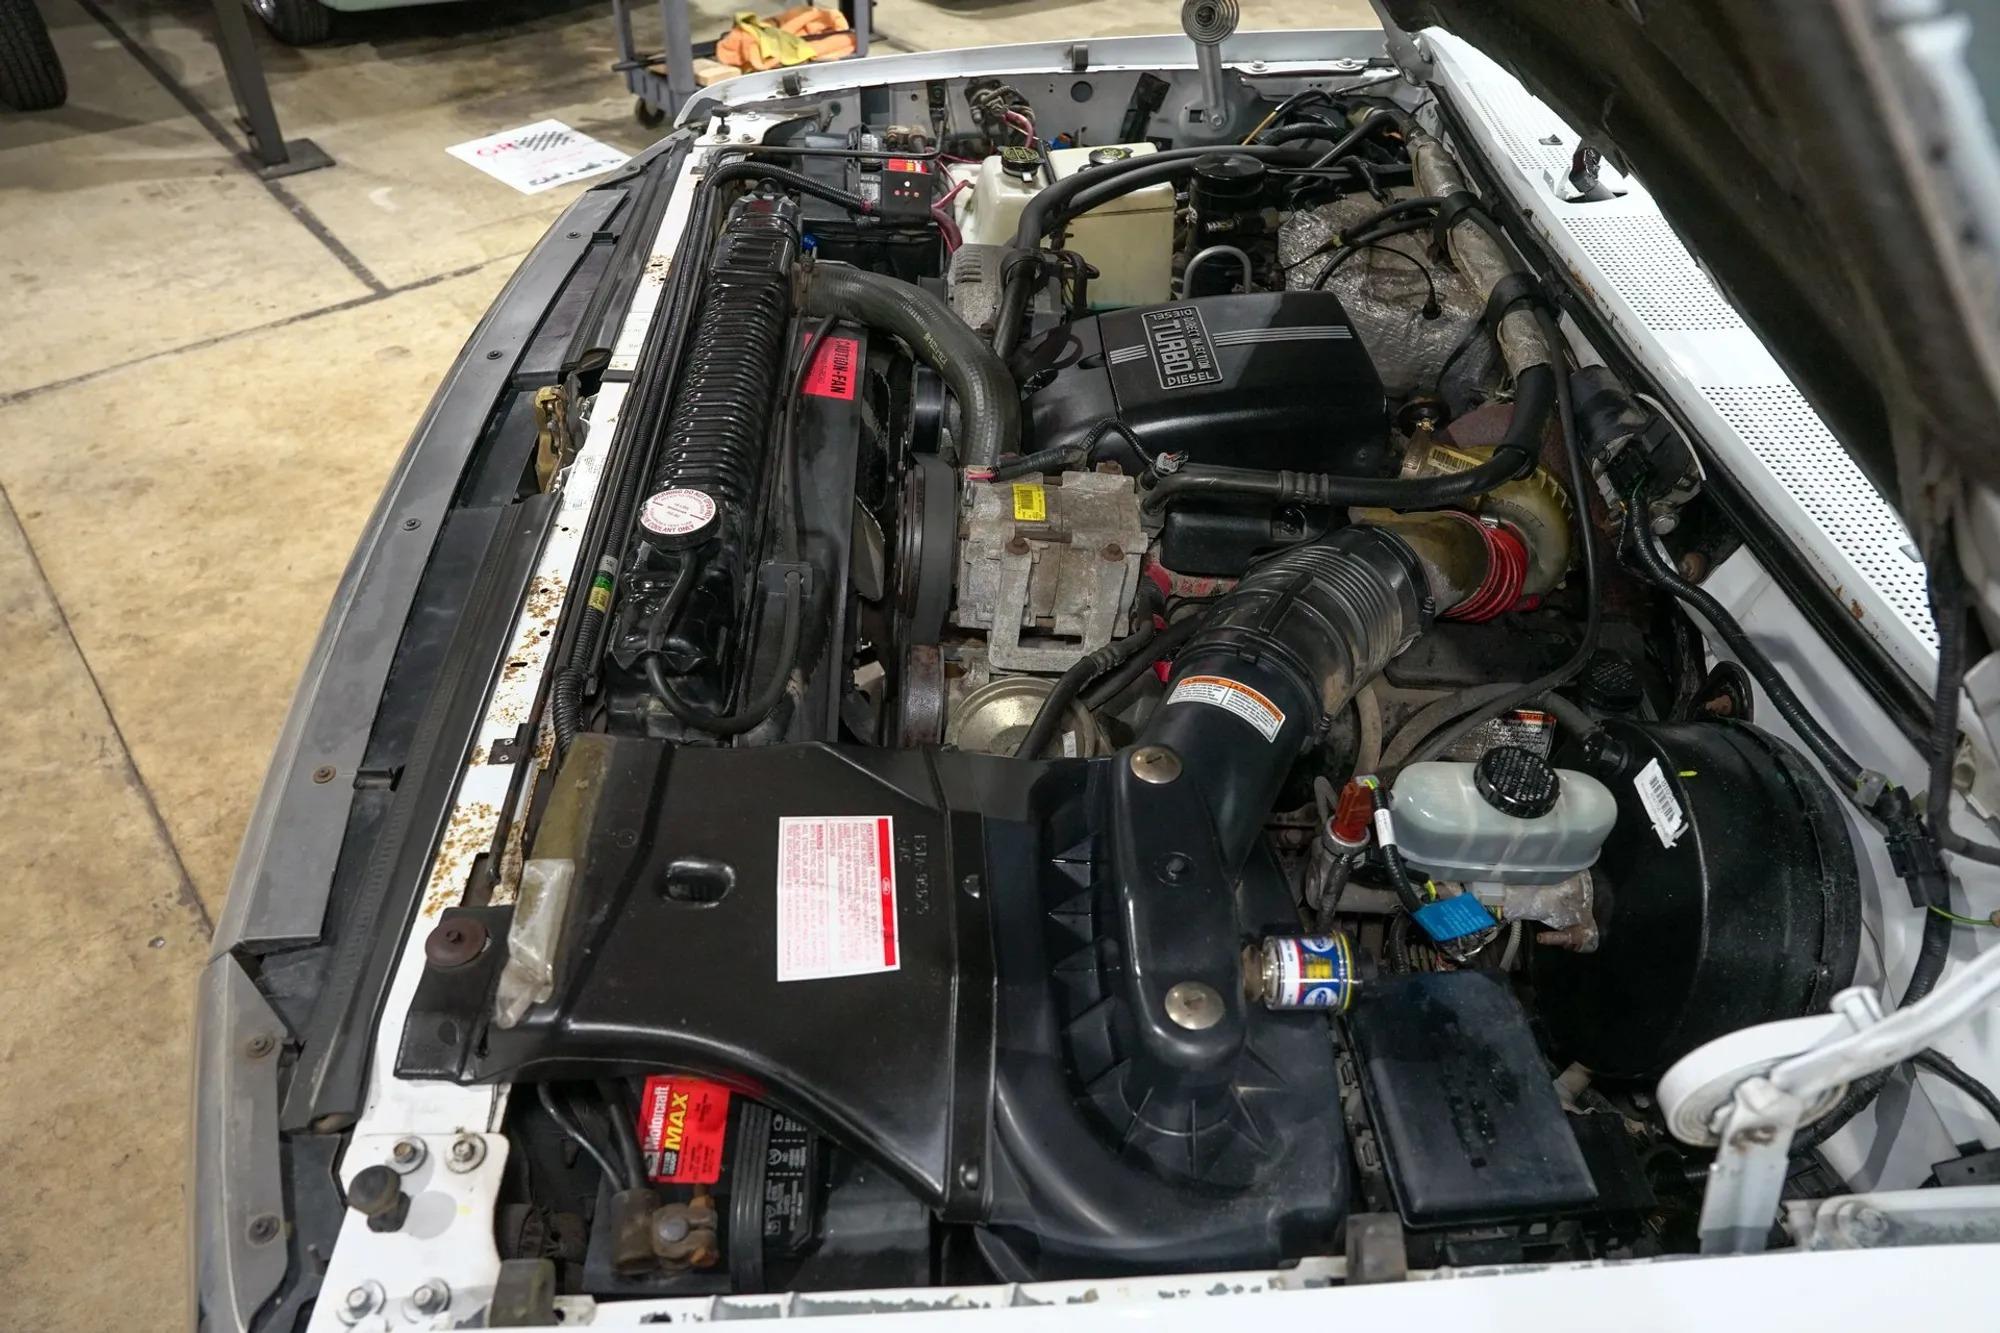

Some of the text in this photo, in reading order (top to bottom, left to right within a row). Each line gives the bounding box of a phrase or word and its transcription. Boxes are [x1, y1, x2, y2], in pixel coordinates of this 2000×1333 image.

[1150, 309, 1192, 320] DIESEL
[831, 340, 850, 394] CAUTION-FAN
[1152, 320, 1193, 374] TURBO
[1183, 317, 1211, 369] DIRECT INJECTION
[1167, 371, 1214, 386] DIESEL
[644, 1085, 669, 1150] Motorcraft
[665, 1093, 689, 1150] MAX
